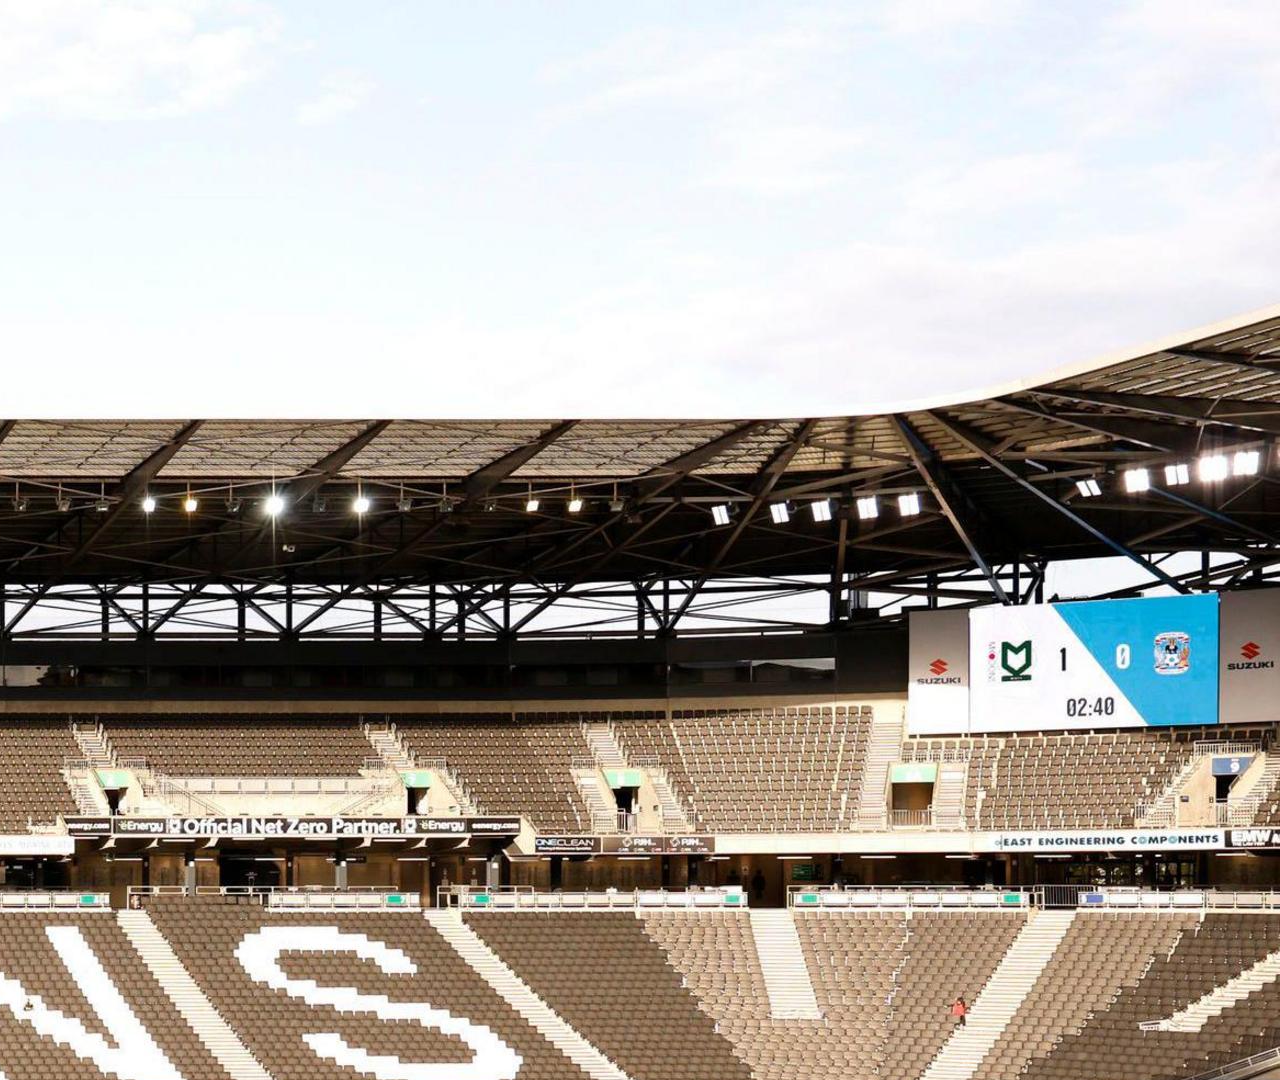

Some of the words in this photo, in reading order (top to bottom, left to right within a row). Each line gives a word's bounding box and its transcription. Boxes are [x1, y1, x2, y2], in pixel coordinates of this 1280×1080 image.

[1060, 647, 1067, 671] 1
[1116, 643, 1131, 670] 0
[1227, 661, 1275, 671] SUZUKI
[916, 677, 961, 685] SUZUKI
[1066, 697, 1115, 717] 02:40
[183, 818, 247, 834] Official
[251, 819, 284, 834] Net
[286, 818, 328, 834] Zero
[331, 818, 401, 834] Partner.
[1038, 836, 1125, 846] ENGINEERING
[1130, 835, 1220, 845] COMPONENTS
[1232, 829, 1271, 842] EMW
[535, 838, 594, 847] ONECLEAN
